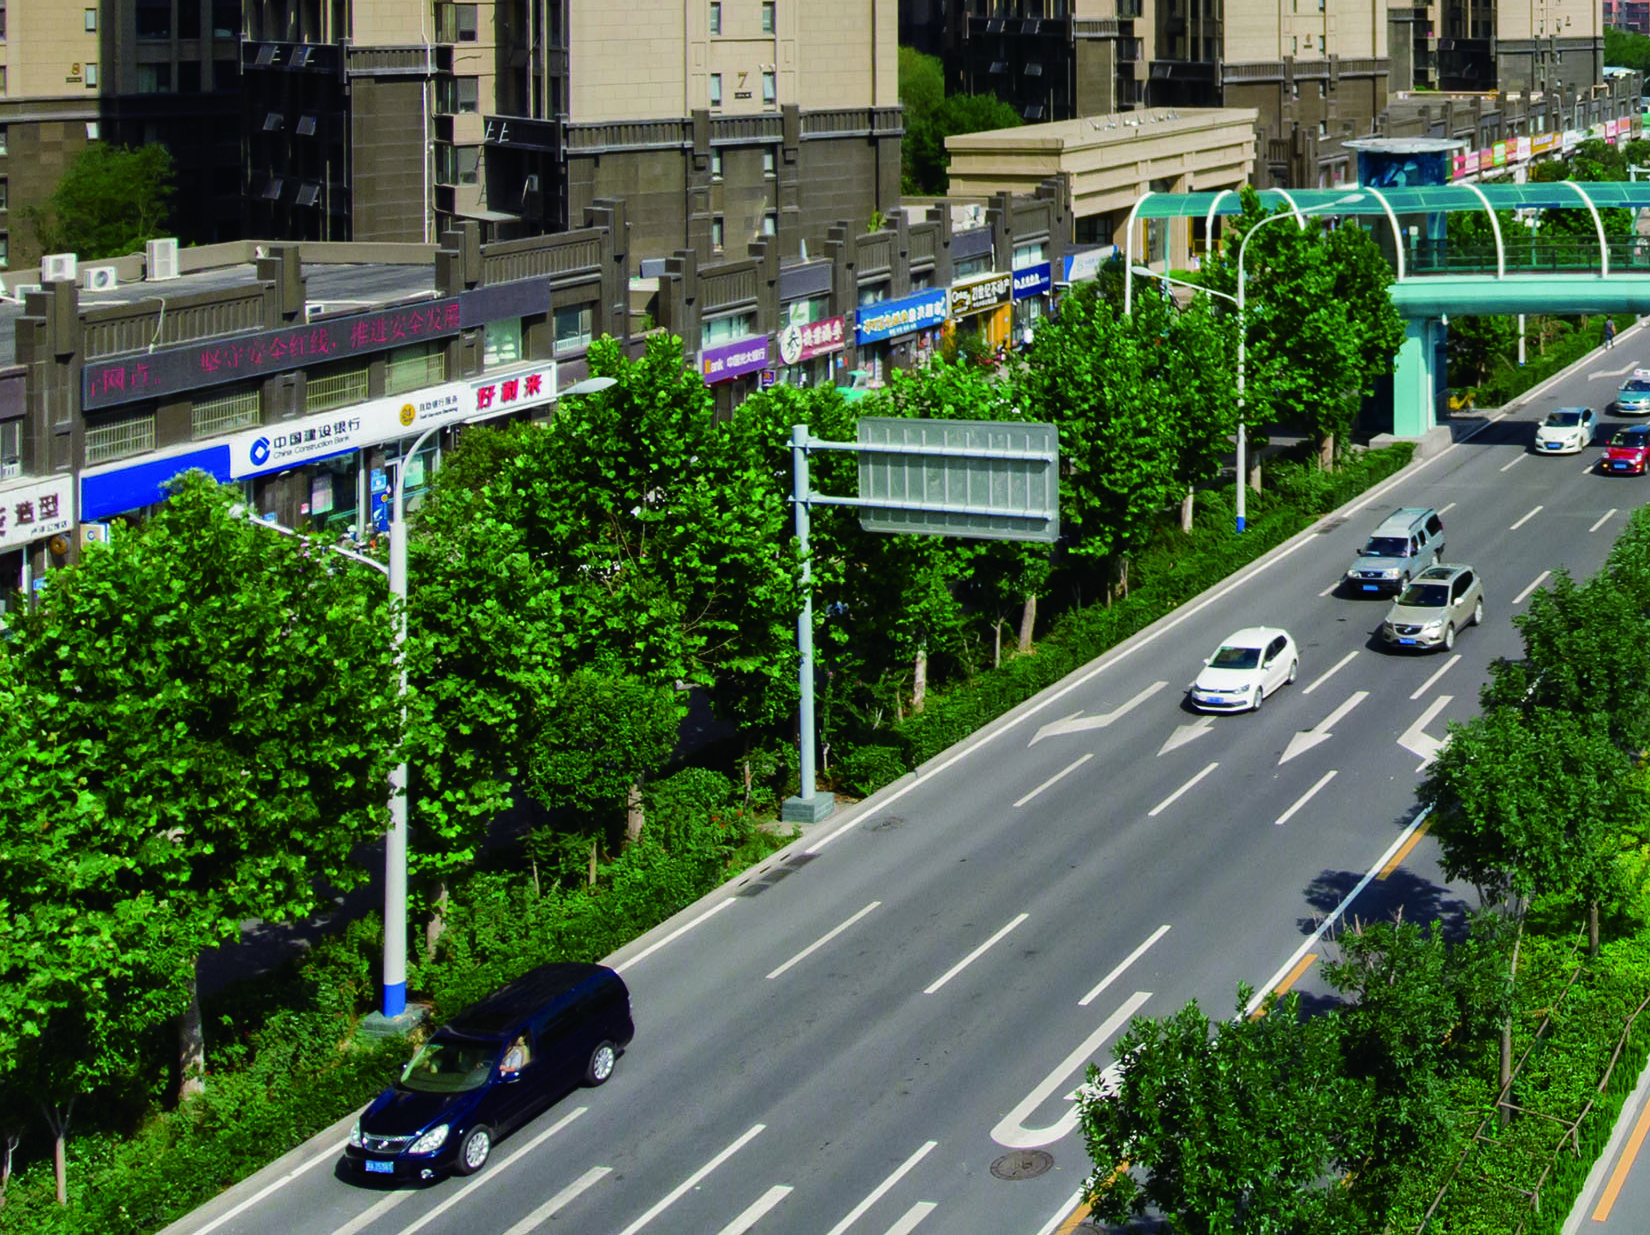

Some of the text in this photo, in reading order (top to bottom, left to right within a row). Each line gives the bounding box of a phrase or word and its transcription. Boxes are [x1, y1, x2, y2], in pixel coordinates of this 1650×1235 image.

[738, 72, 748, 88] 7
[274, 417, 361, 449] 中国建设银行
[273, 435, 350, 459] China Construction Bank
